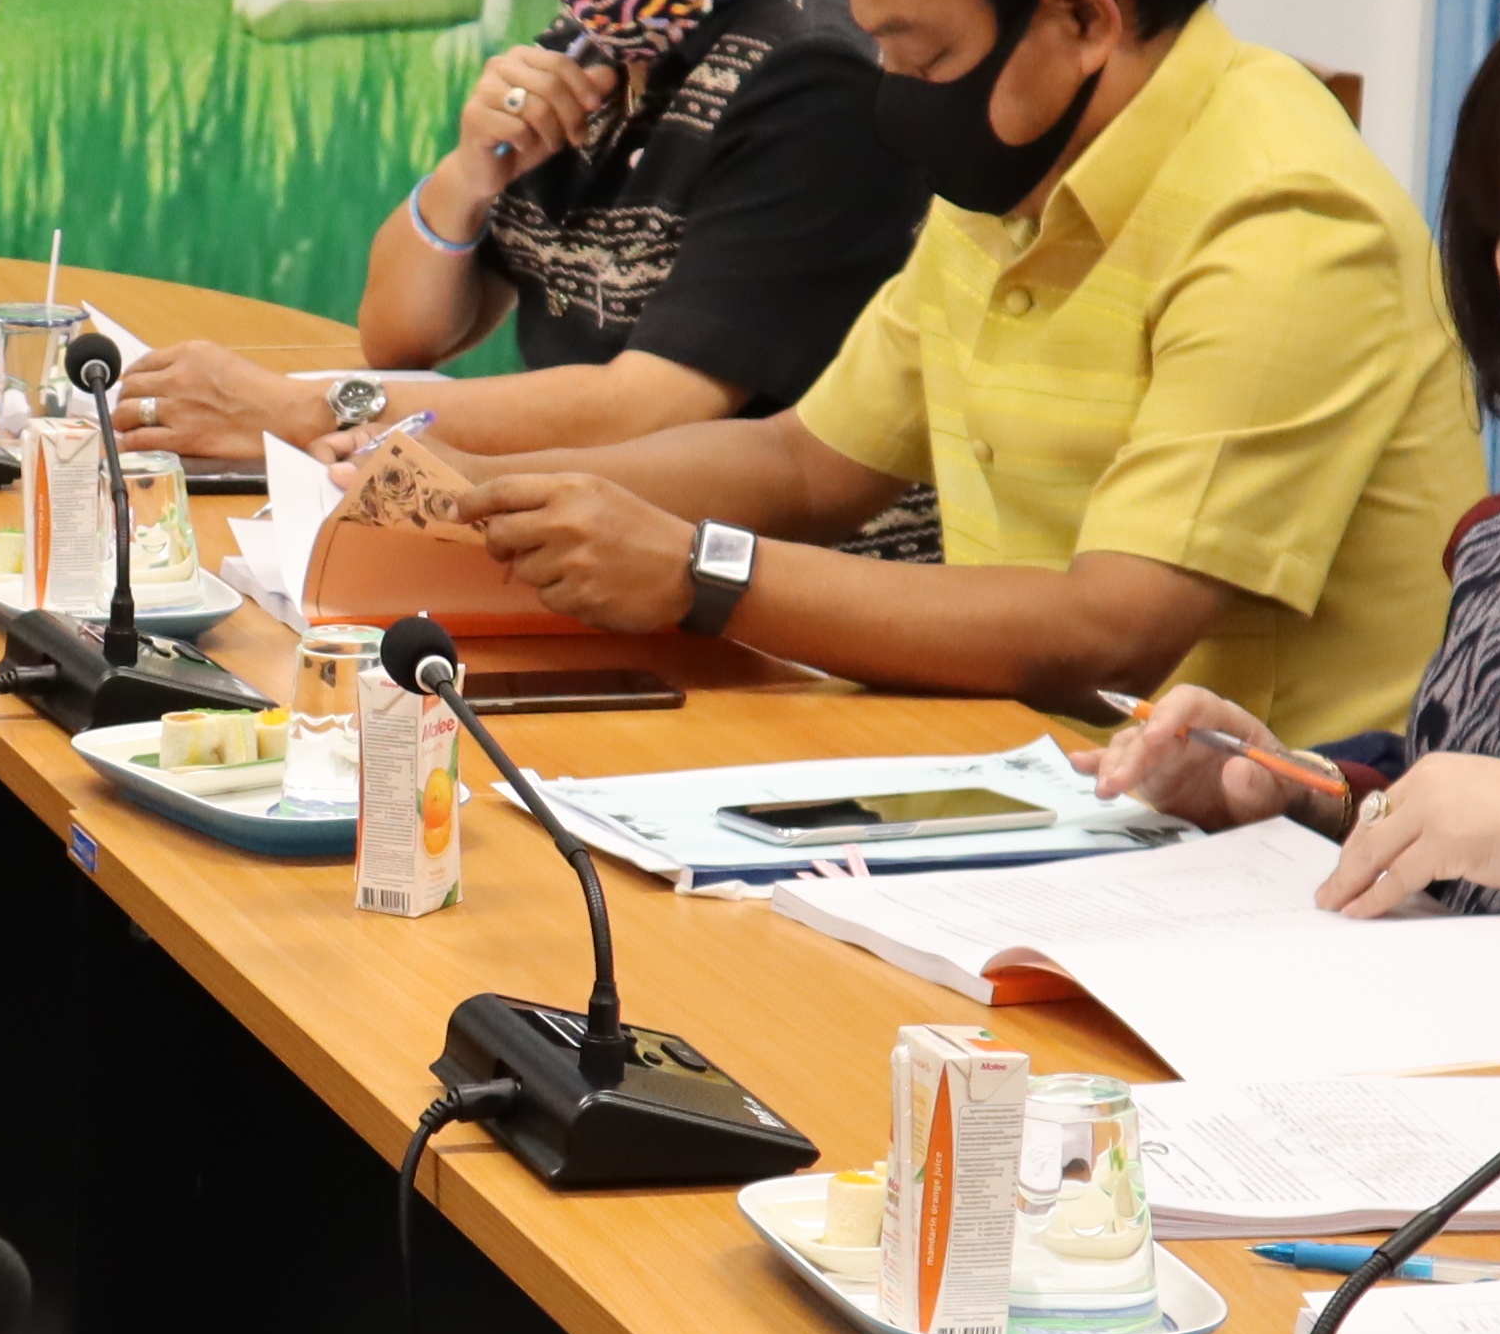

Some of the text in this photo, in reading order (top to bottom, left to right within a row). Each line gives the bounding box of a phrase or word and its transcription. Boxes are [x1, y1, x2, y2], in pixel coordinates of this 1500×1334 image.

[926, 1150, 944, 1267] mandarin orange juice
